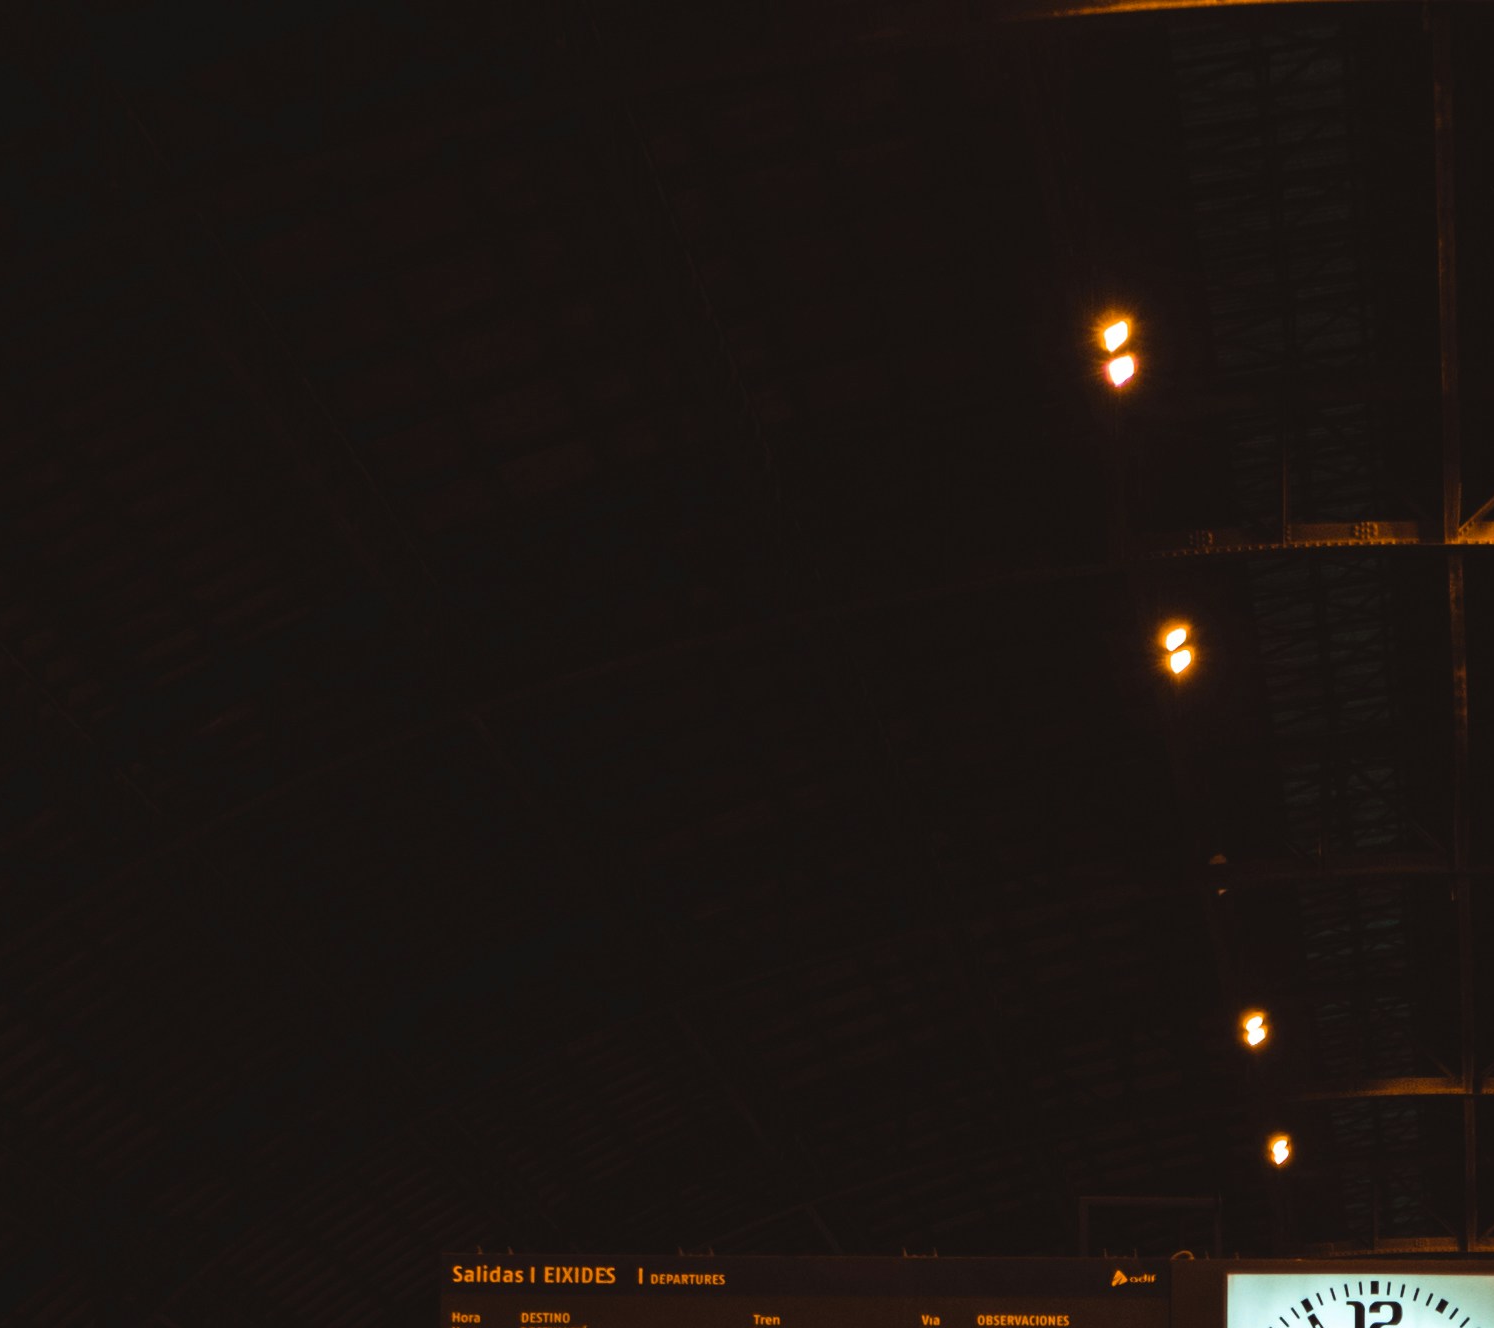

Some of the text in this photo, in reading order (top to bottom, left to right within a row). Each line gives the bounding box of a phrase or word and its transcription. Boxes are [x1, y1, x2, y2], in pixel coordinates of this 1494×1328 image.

[452, 1264, 726, 1286] Salidas EIXIDES DEPARTURES
[451, 1312, 482, 1324] Hora
[520, 1312, 571, 1324] DESTINO
[752, 1313, 781, 1325] Tren
[977, 1313, 1071, 1326] OBSERVACIONES
